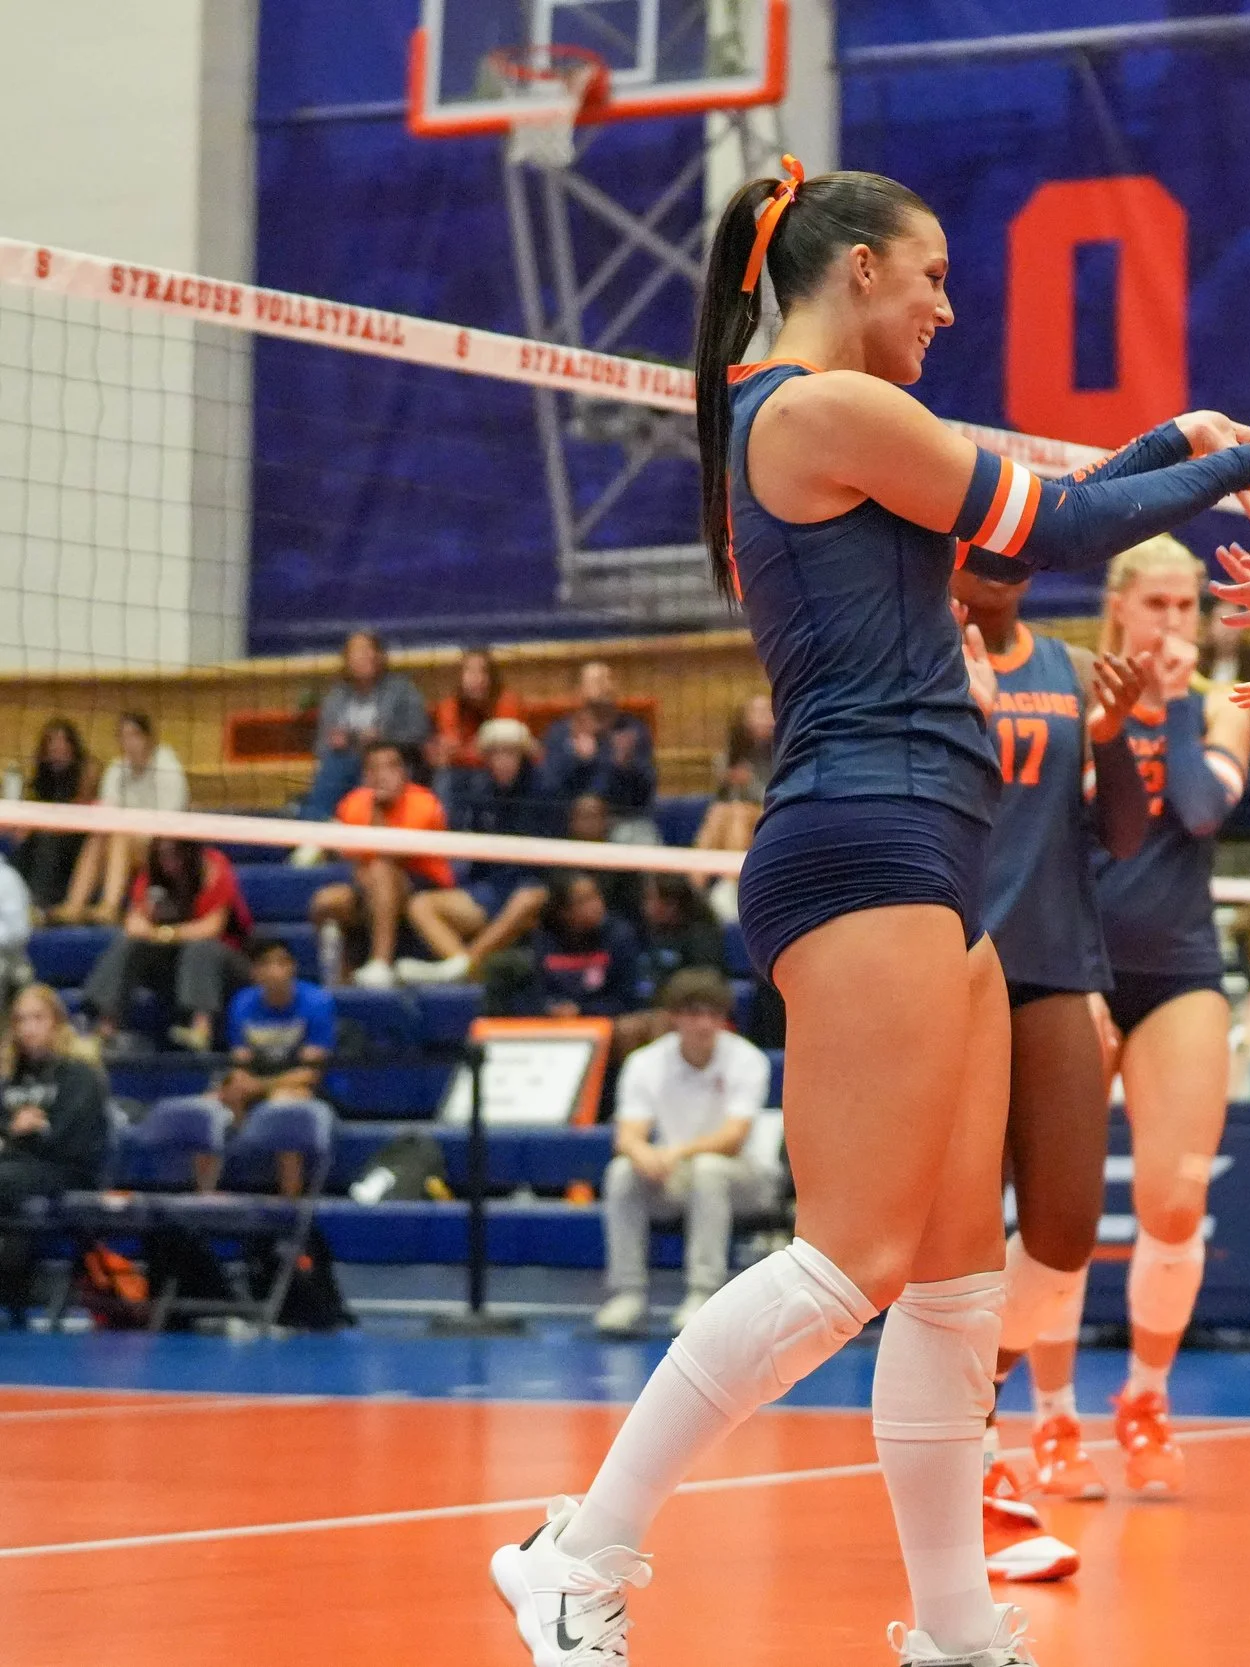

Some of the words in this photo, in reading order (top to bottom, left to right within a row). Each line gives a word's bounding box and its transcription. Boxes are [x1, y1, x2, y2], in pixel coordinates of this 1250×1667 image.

[109, 263, 244, 317] SYRACUSE
[254, 290, 406, 347] VOLLEYBALL
[519, 343, 629, 389] SYRACUSE
[996, 718, 1048, 785] 17
